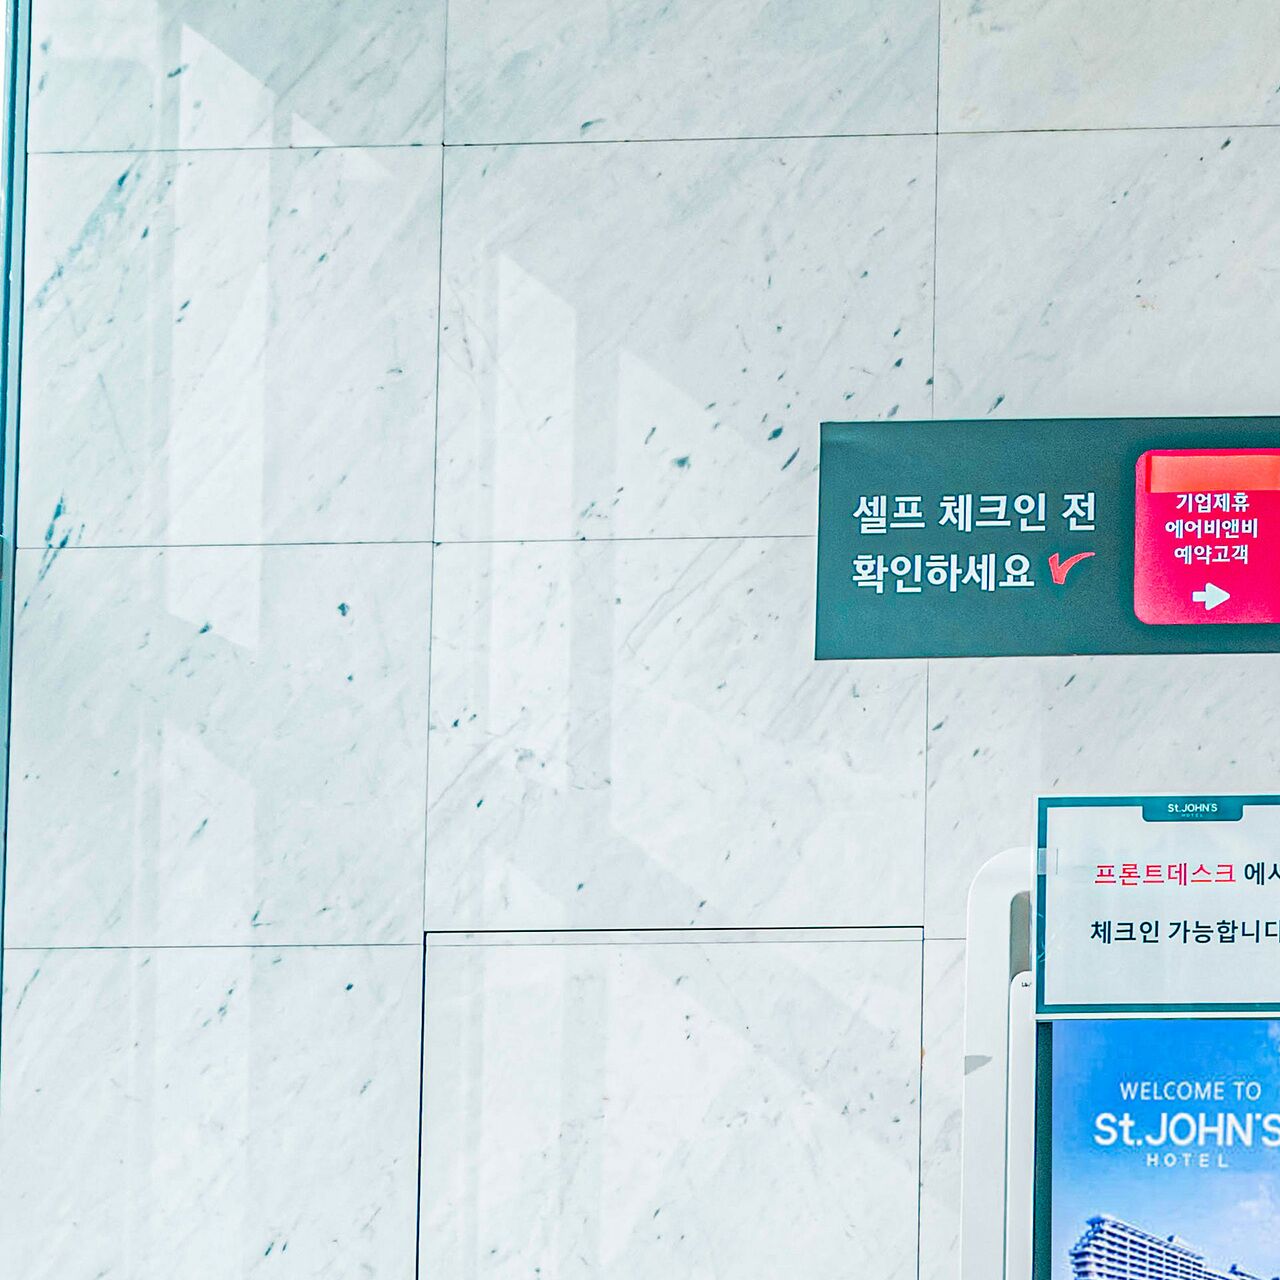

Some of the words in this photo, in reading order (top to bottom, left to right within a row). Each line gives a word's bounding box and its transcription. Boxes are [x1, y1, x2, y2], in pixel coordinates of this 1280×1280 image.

[853, 494, 926, 534] 셀프
[940, 493, 1046, 532] 체크인
[1062, 493, 1096, 531] 전
[1176, 493, 1249, 513] 기업제휴
[1165, 518, 1258, 540] 에어비앤비
[1174, 544, 1249, 565] 예약고객
[852, 552, 1035, 593] 확인하세요
[1094, 863, 1236, 886] 프론트데스크
[1091, 921, 1160, 944] 체크인
[1120, 1081, 1224, 1101] WELCOME
[1233, 1081, 1261, 1101] TO
[1147, 1153, 1229, 1168] HOTEL
